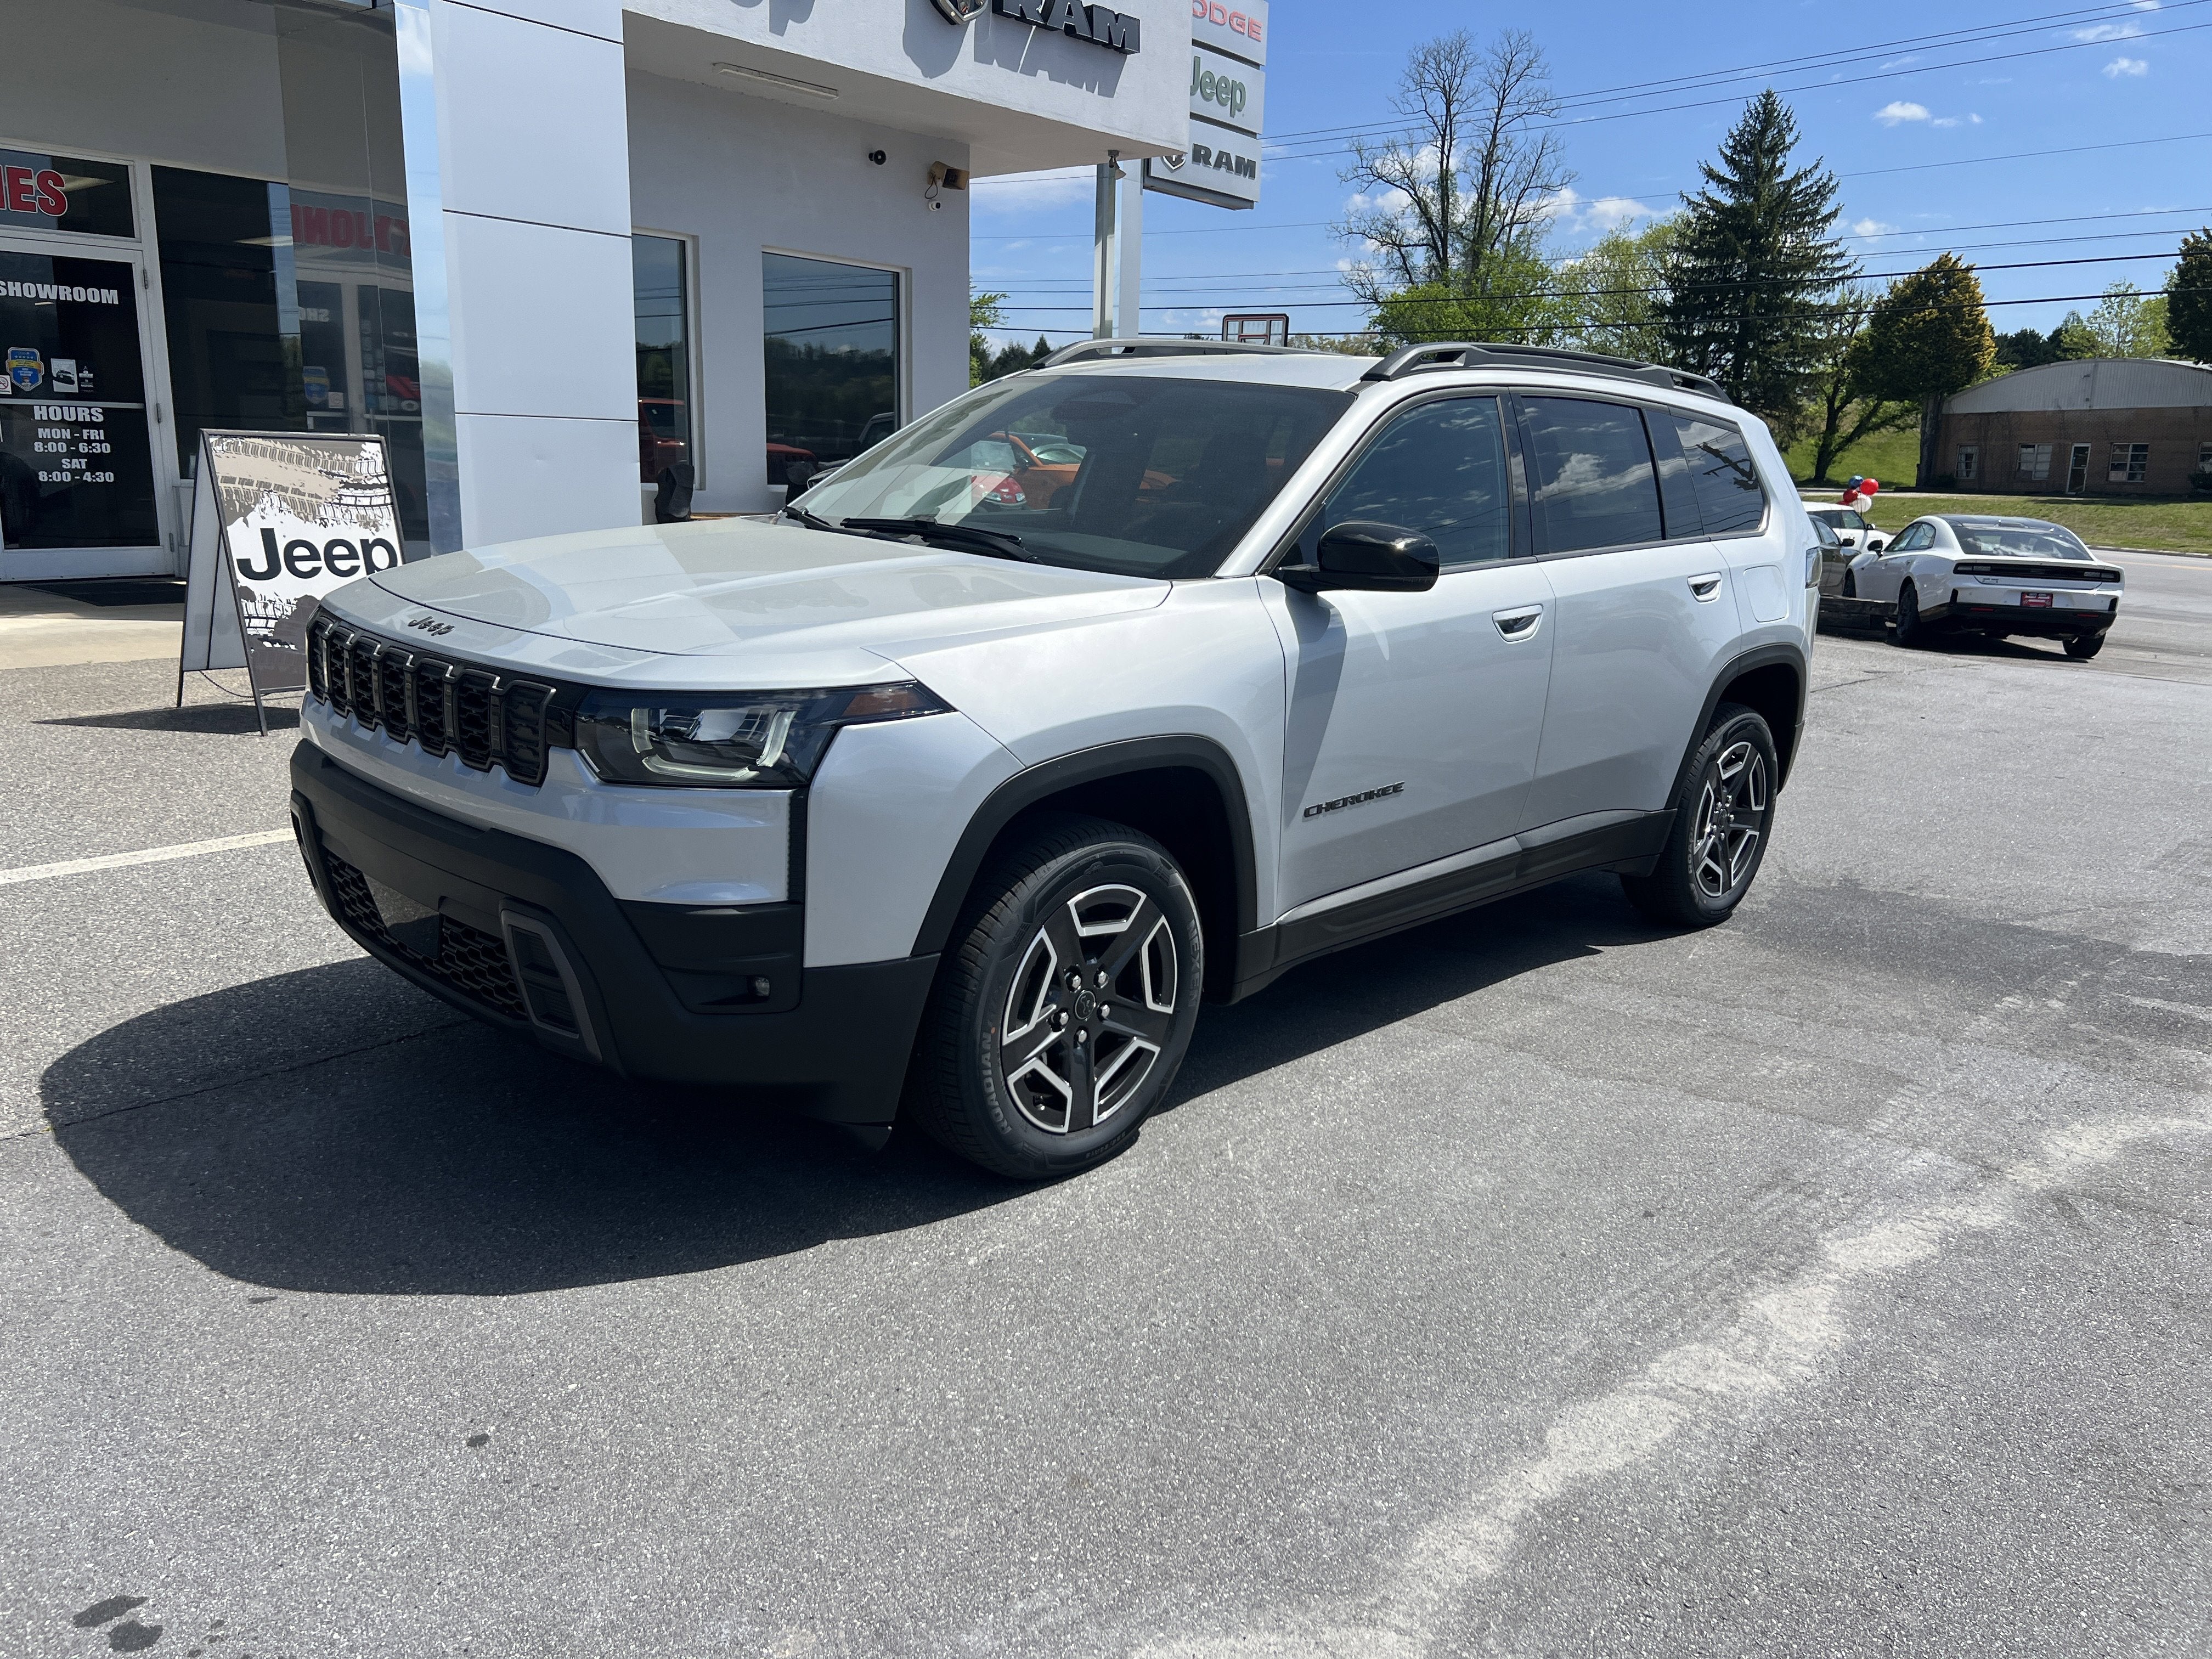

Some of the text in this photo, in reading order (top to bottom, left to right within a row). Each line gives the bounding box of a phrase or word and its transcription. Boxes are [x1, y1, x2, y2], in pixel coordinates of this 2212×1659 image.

[1190, 55, 1246, 118] Jeep
[1192, 143, 1256, 180] RAM
[0, 166, 67, 217] ES
[0, 280, 119, 304] SHOWROOM
[33, 405, 104, 422] HOURS
[33, 442, 67, 453] 8:00
[78, 442, 111, 454] 6:30
[37, 428, 71, 439] MON
[82, 429, 105, 440] FRI
[38, 471, 71, 482] 8:00
[83, 472, 114, 482] 4:30
[61, 458, 87, 469] SAT
[236, 528, 398, 580] Jeep
[408, 616, 455, 636] Jeep
[1304, 781, 1405, 818] CHEROKEE
[1187, 919, 1200, 1007] NEXEN
[981, 1031, 1012, 1135] ROADIAN
